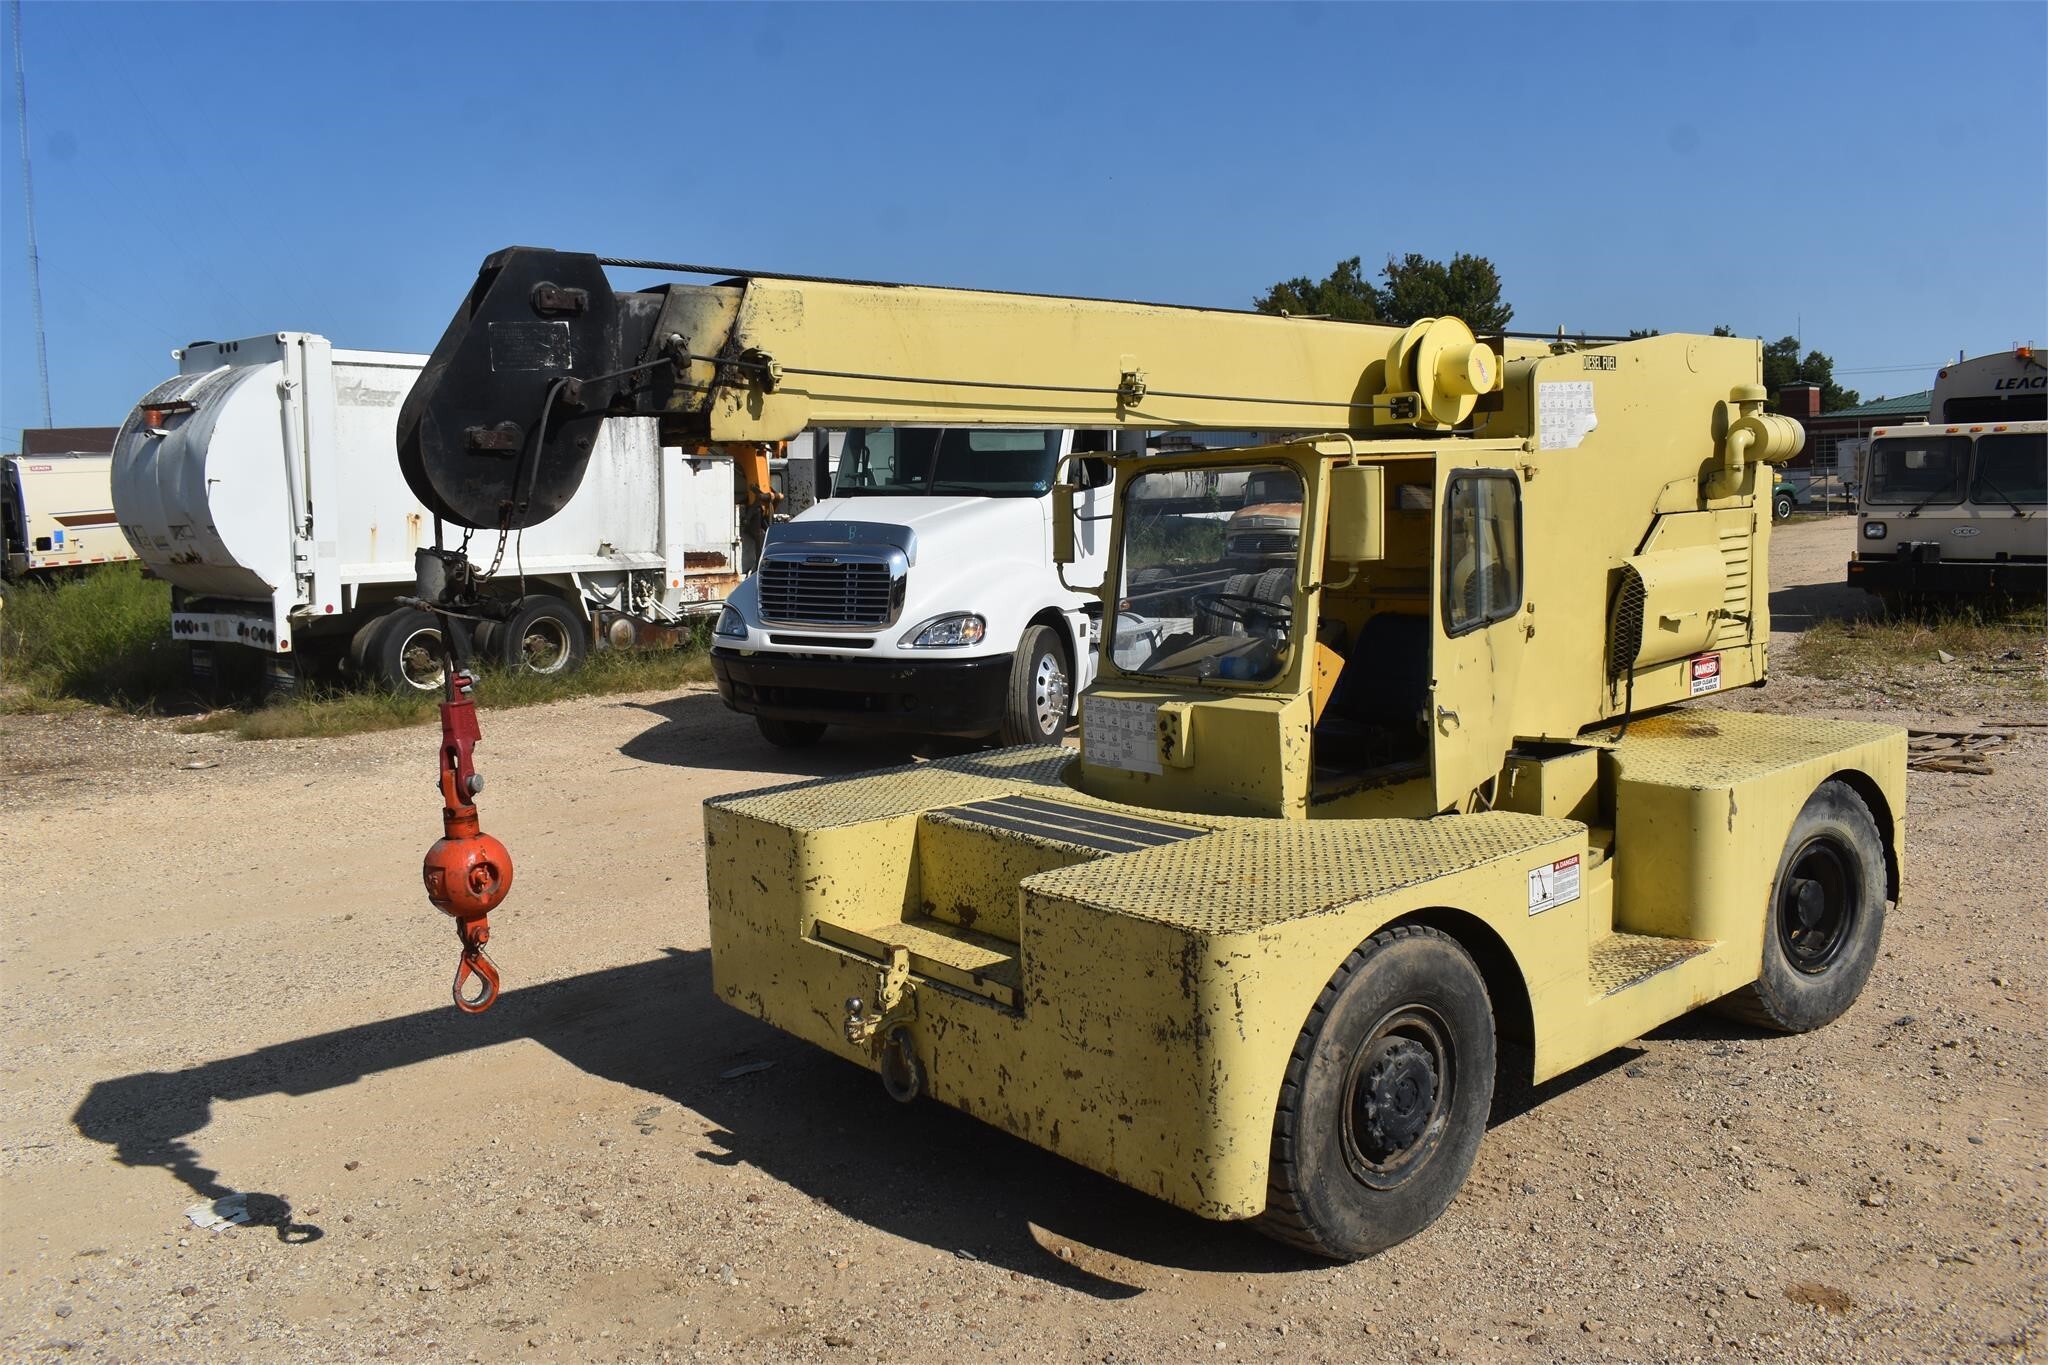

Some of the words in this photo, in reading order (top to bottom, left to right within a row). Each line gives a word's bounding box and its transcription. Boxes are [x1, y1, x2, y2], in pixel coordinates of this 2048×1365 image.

[1603, 356, 1616, 370] FUEL
[1694, 661, 1717, 676] DANGER
[1559, 856, 1578, 868] DANGER
